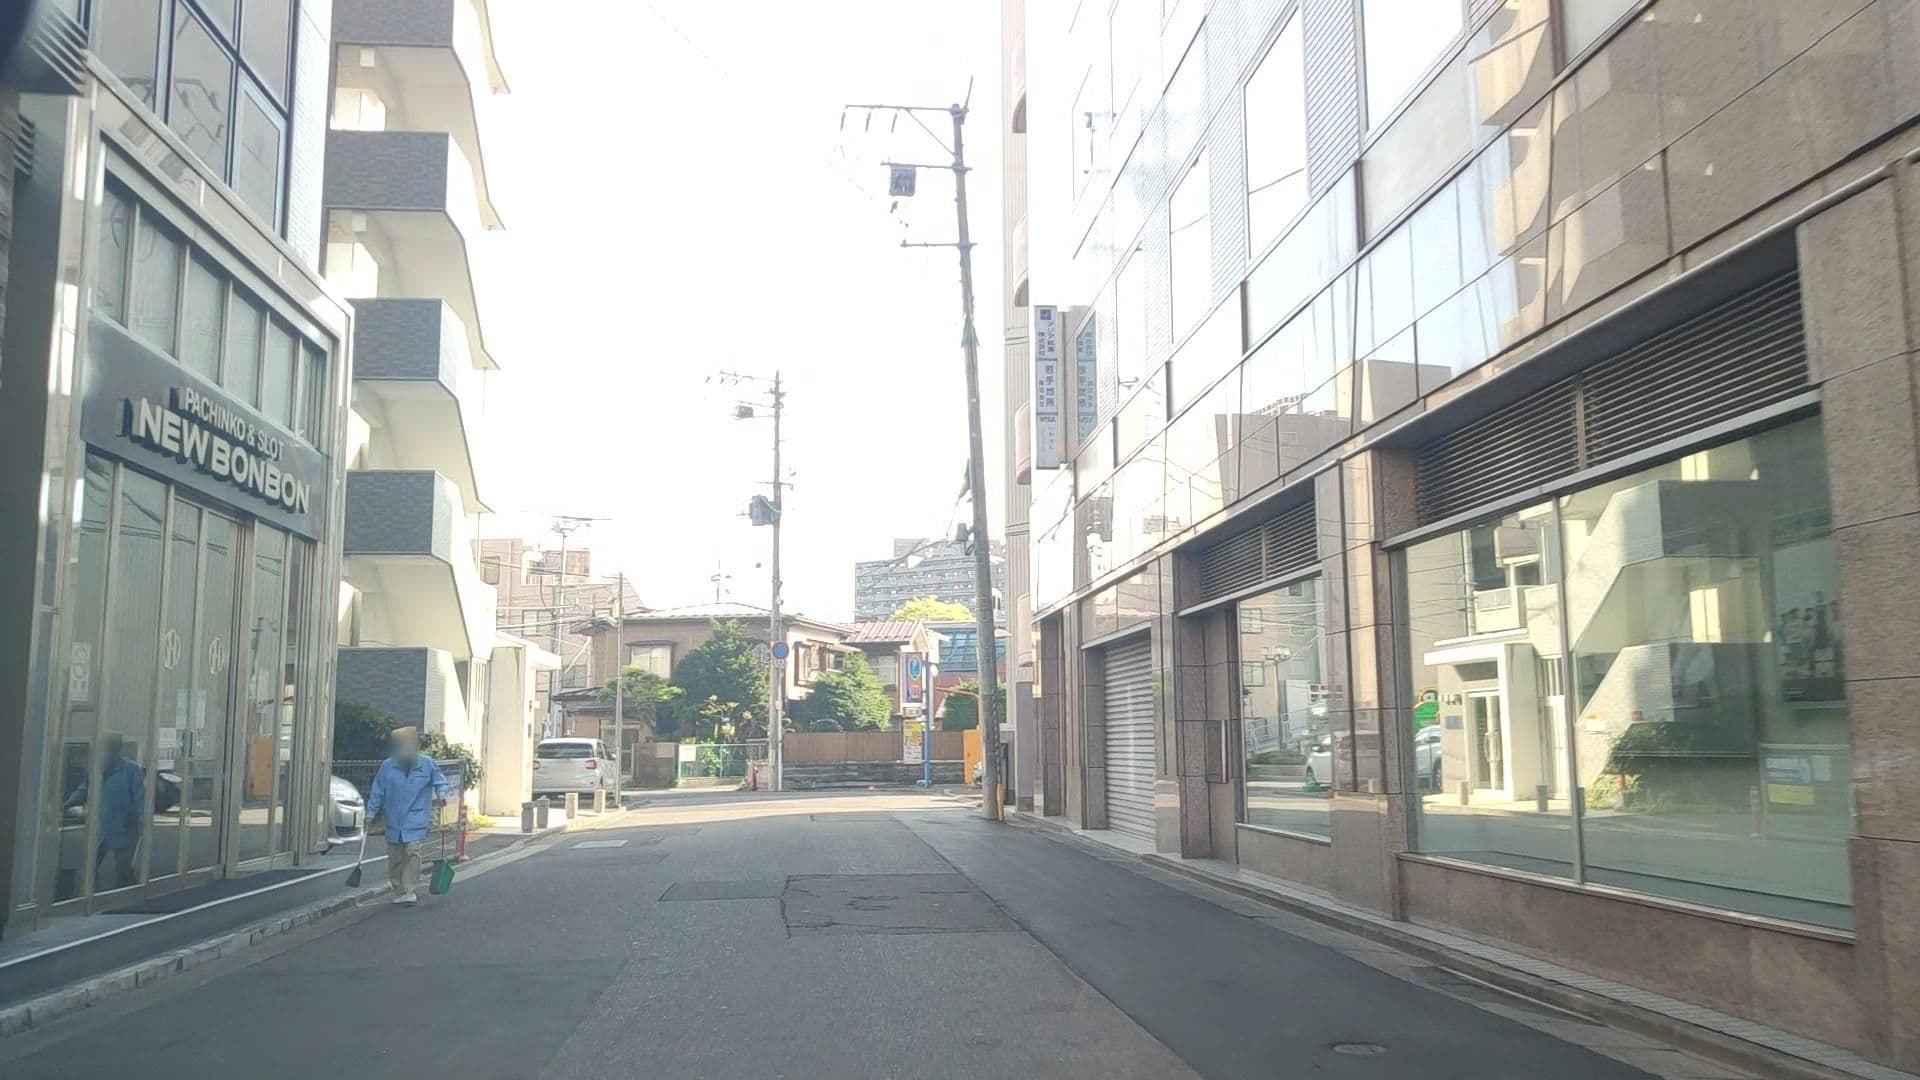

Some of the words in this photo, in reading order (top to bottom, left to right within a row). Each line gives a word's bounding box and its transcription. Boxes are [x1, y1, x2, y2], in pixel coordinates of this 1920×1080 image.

[185, 388, 246, 441] PACHINKO
[247, 424, 255, 447] &
[257, 431, 285, 462] SLOT
